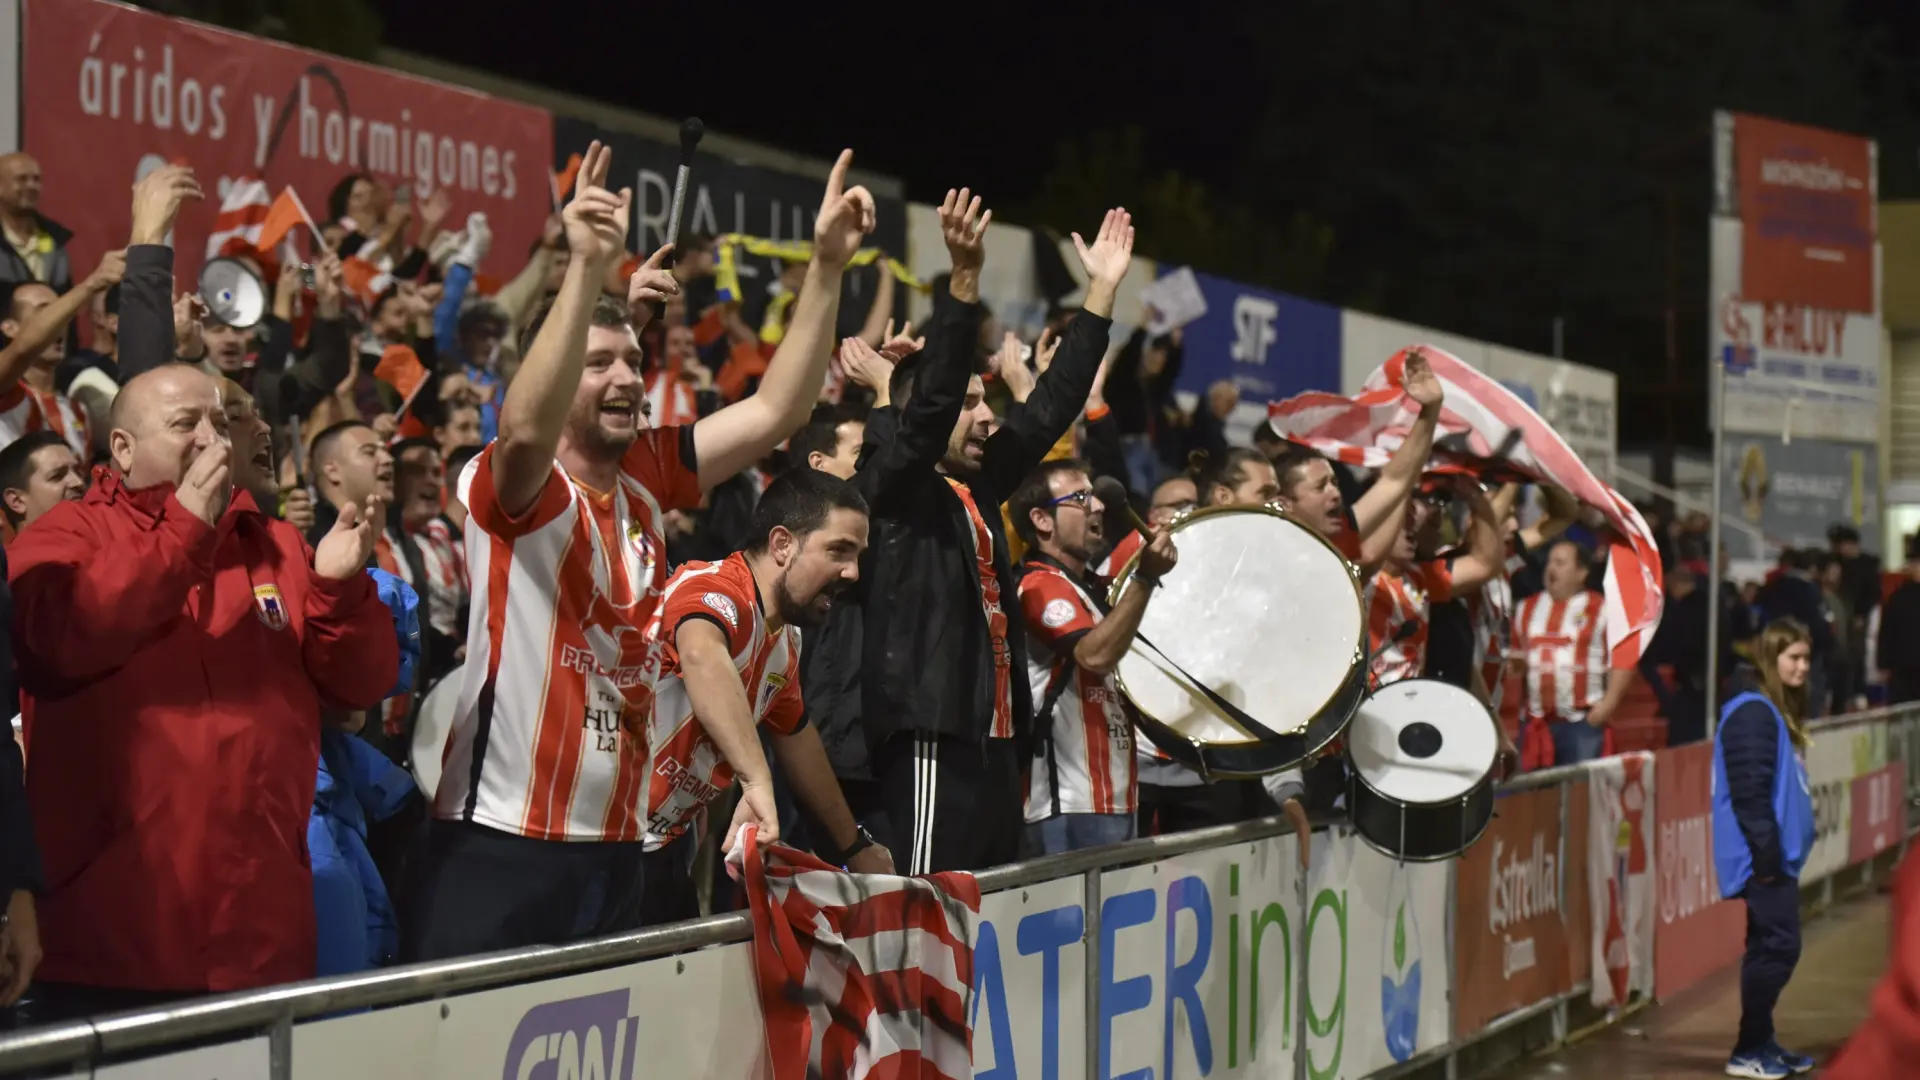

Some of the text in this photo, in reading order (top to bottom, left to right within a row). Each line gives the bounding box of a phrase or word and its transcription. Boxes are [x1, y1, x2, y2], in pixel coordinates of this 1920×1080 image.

[79, 33, 227, 140] áridos
[253, 94, 275, 168] y
[300, 75, 517, 199] hormigones
[637, 168, 861, 297] RALU
[1489, 831, 1557, 936] Estrella
[972, 863, 1347, 1080] ATERing
